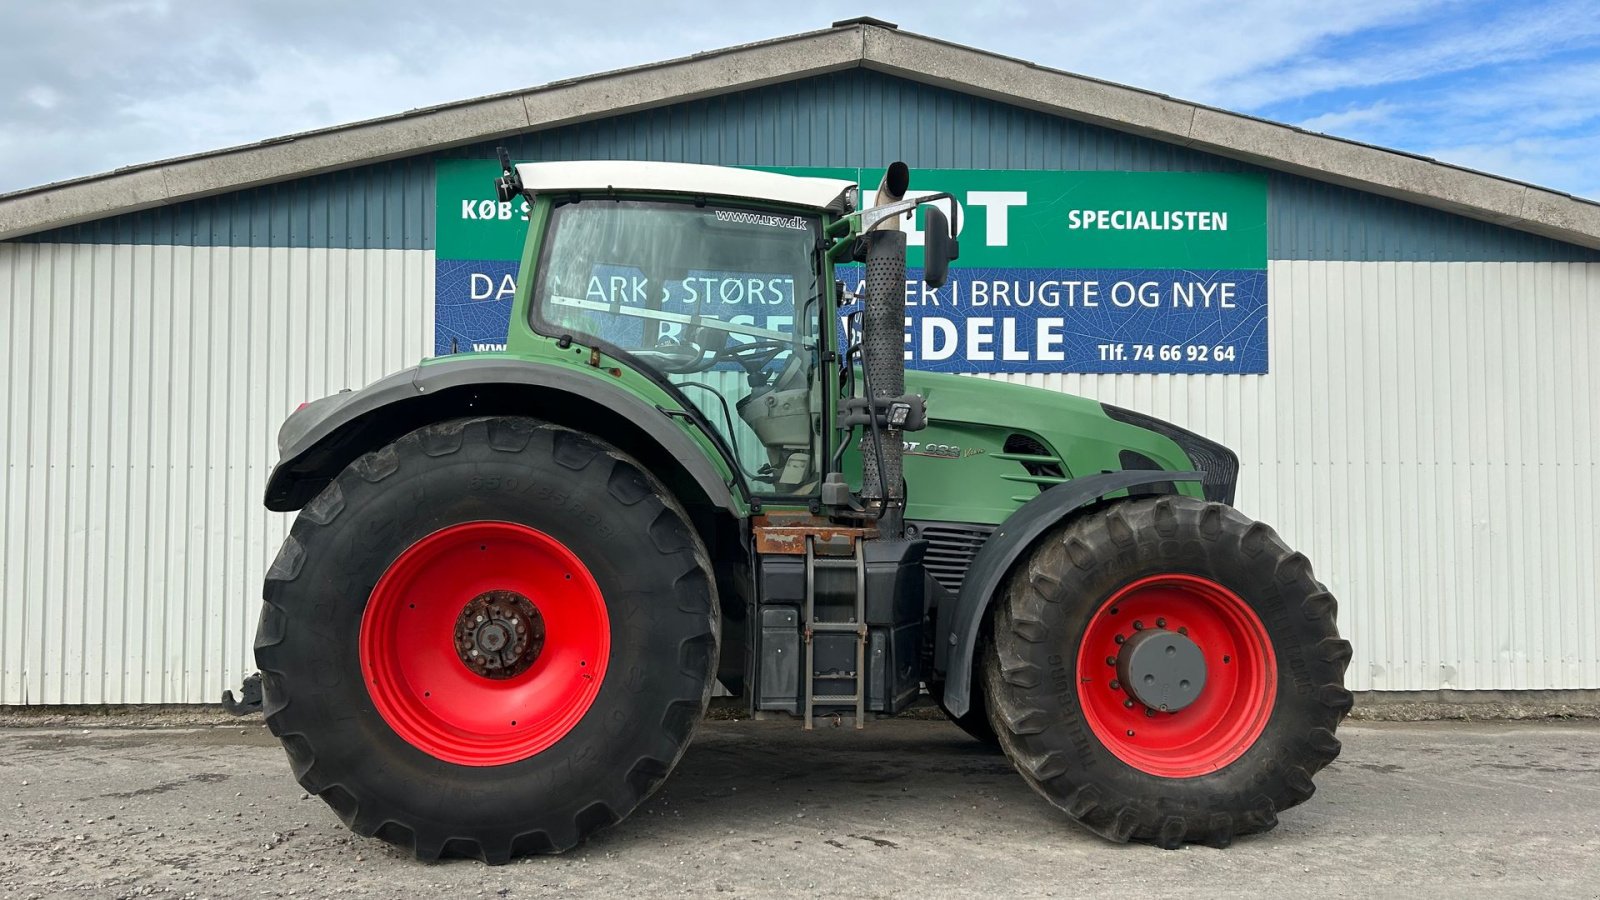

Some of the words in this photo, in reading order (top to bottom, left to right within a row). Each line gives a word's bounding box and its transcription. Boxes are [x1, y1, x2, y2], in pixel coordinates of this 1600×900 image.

[714, 210, 807, 230] www.usv.dk
[1069, 210, 1227, 231] SPECIALISTEN
[682, 274, 795, 303] STØRST
[953, 281, 958, 306] I
[972, 281, 1099, 306] BRUGTE
[1111, 282, 1159, 308] OG
[1174, 283, 1236, 308] NYE
[1098, 344, 1127, 361] Tlf.
[1133, 345, 1154, 361] 74
[1159, 345, 1183, 361] 66
[1187, 345, 1211, 361] 92
[1214, 345, 1236, 361] 64
[1047, 654, 1097, 772] TRELLEBORG
